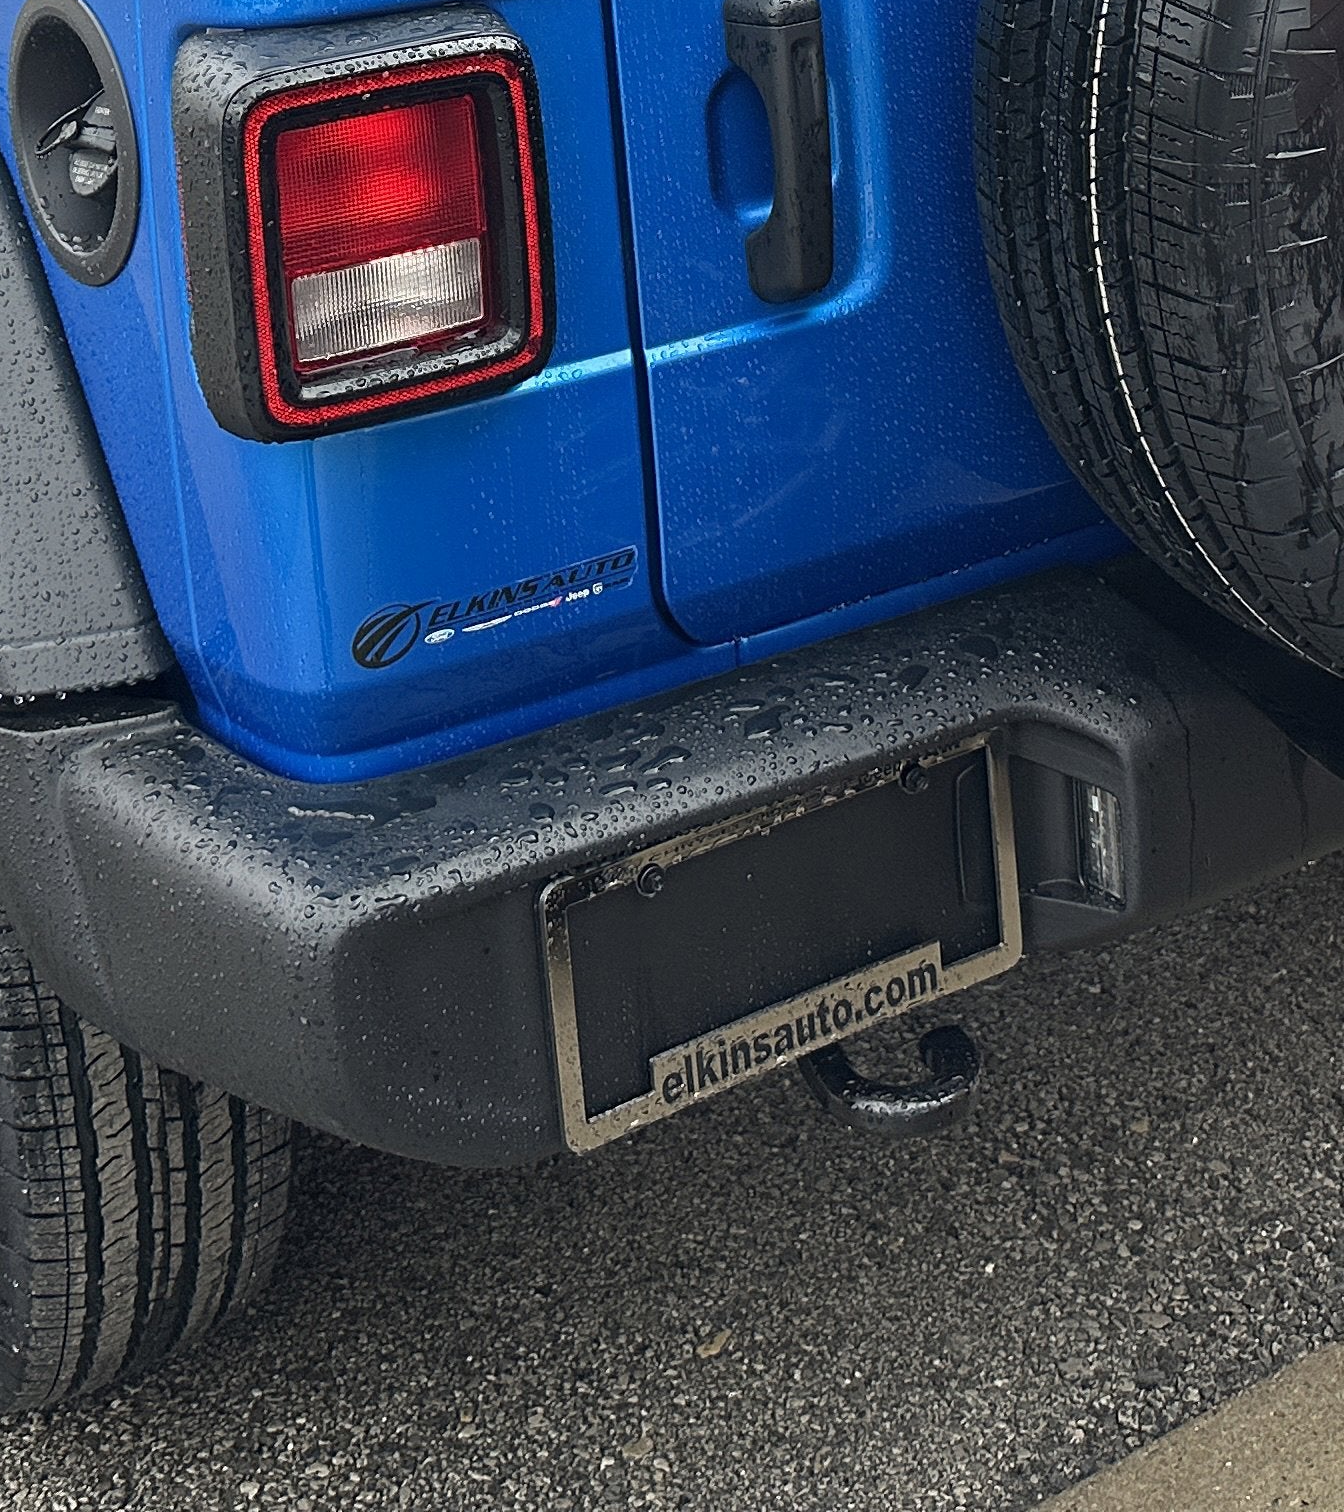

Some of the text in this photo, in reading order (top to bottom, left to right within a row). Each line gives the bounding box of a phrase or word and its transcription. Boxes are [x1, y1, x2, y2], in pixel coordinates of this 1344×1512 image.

[429, 577, 543, 627] ELKINS
[542, 551, 635, 593] AUTO
[566, 587, 591, 603] Jeep
[660, 955, 940, 1106] elkinsauto.com
